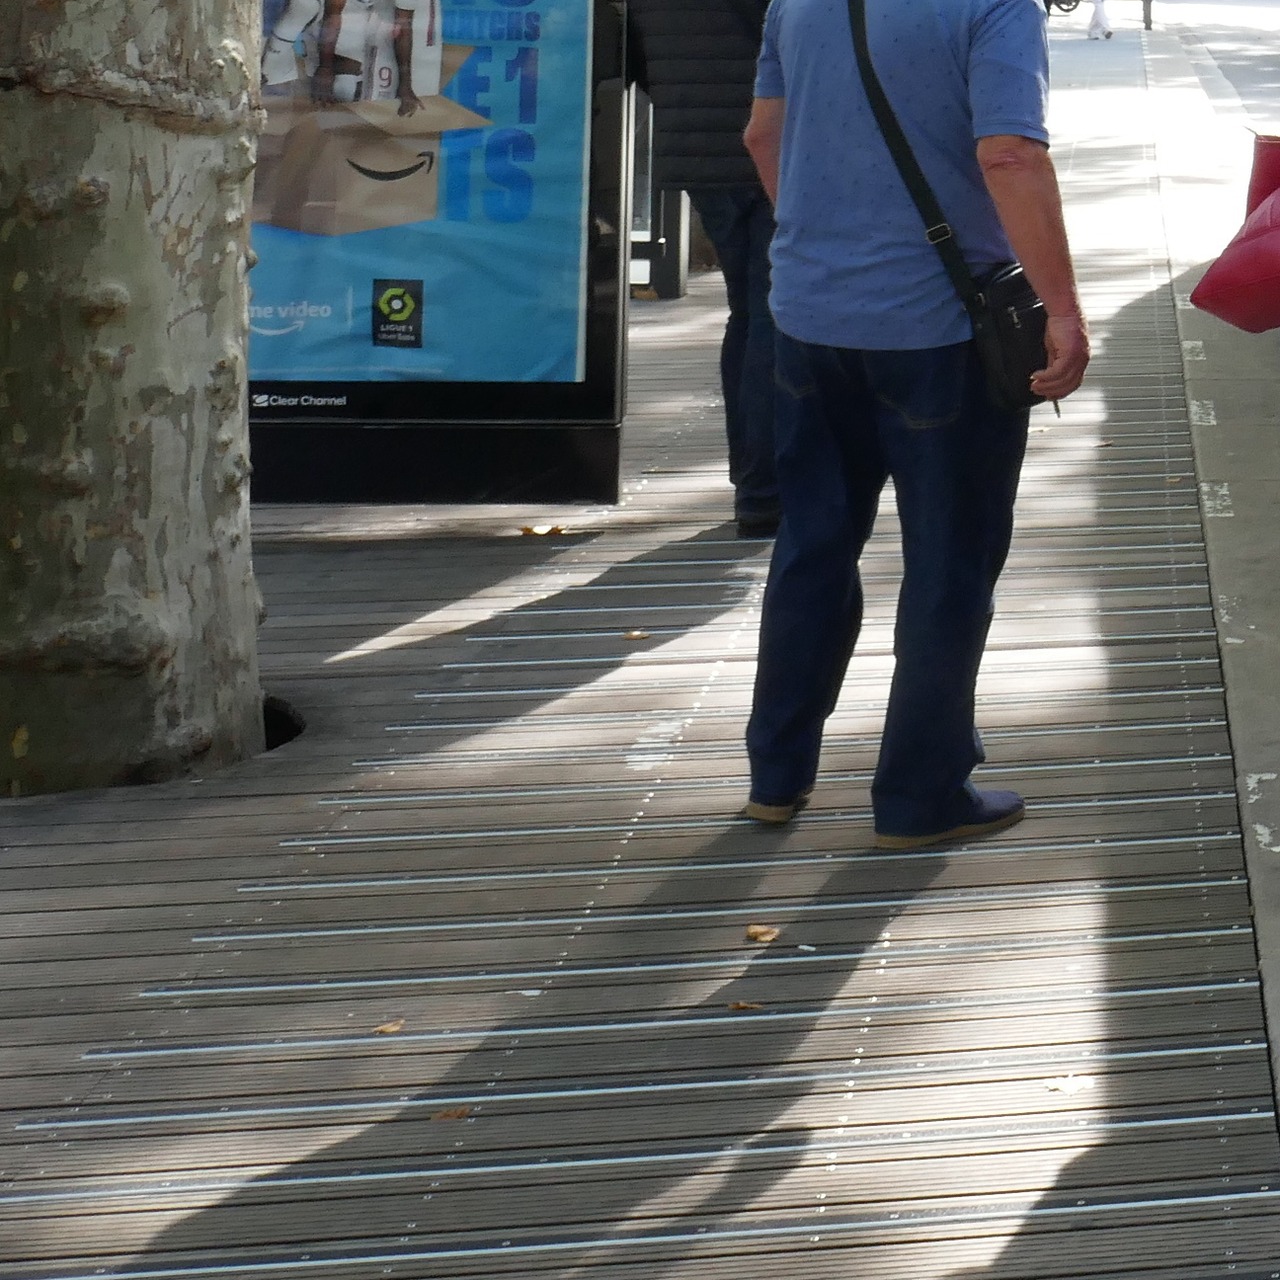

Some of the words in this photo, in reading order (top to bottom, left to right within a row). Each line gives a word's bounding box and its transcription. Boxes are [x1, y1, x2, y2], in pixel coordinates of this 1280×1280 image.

[278, 300, 333, 318] video
[269, 394, 299, 406] Clear
[300, 395, 347, 406] Channel
